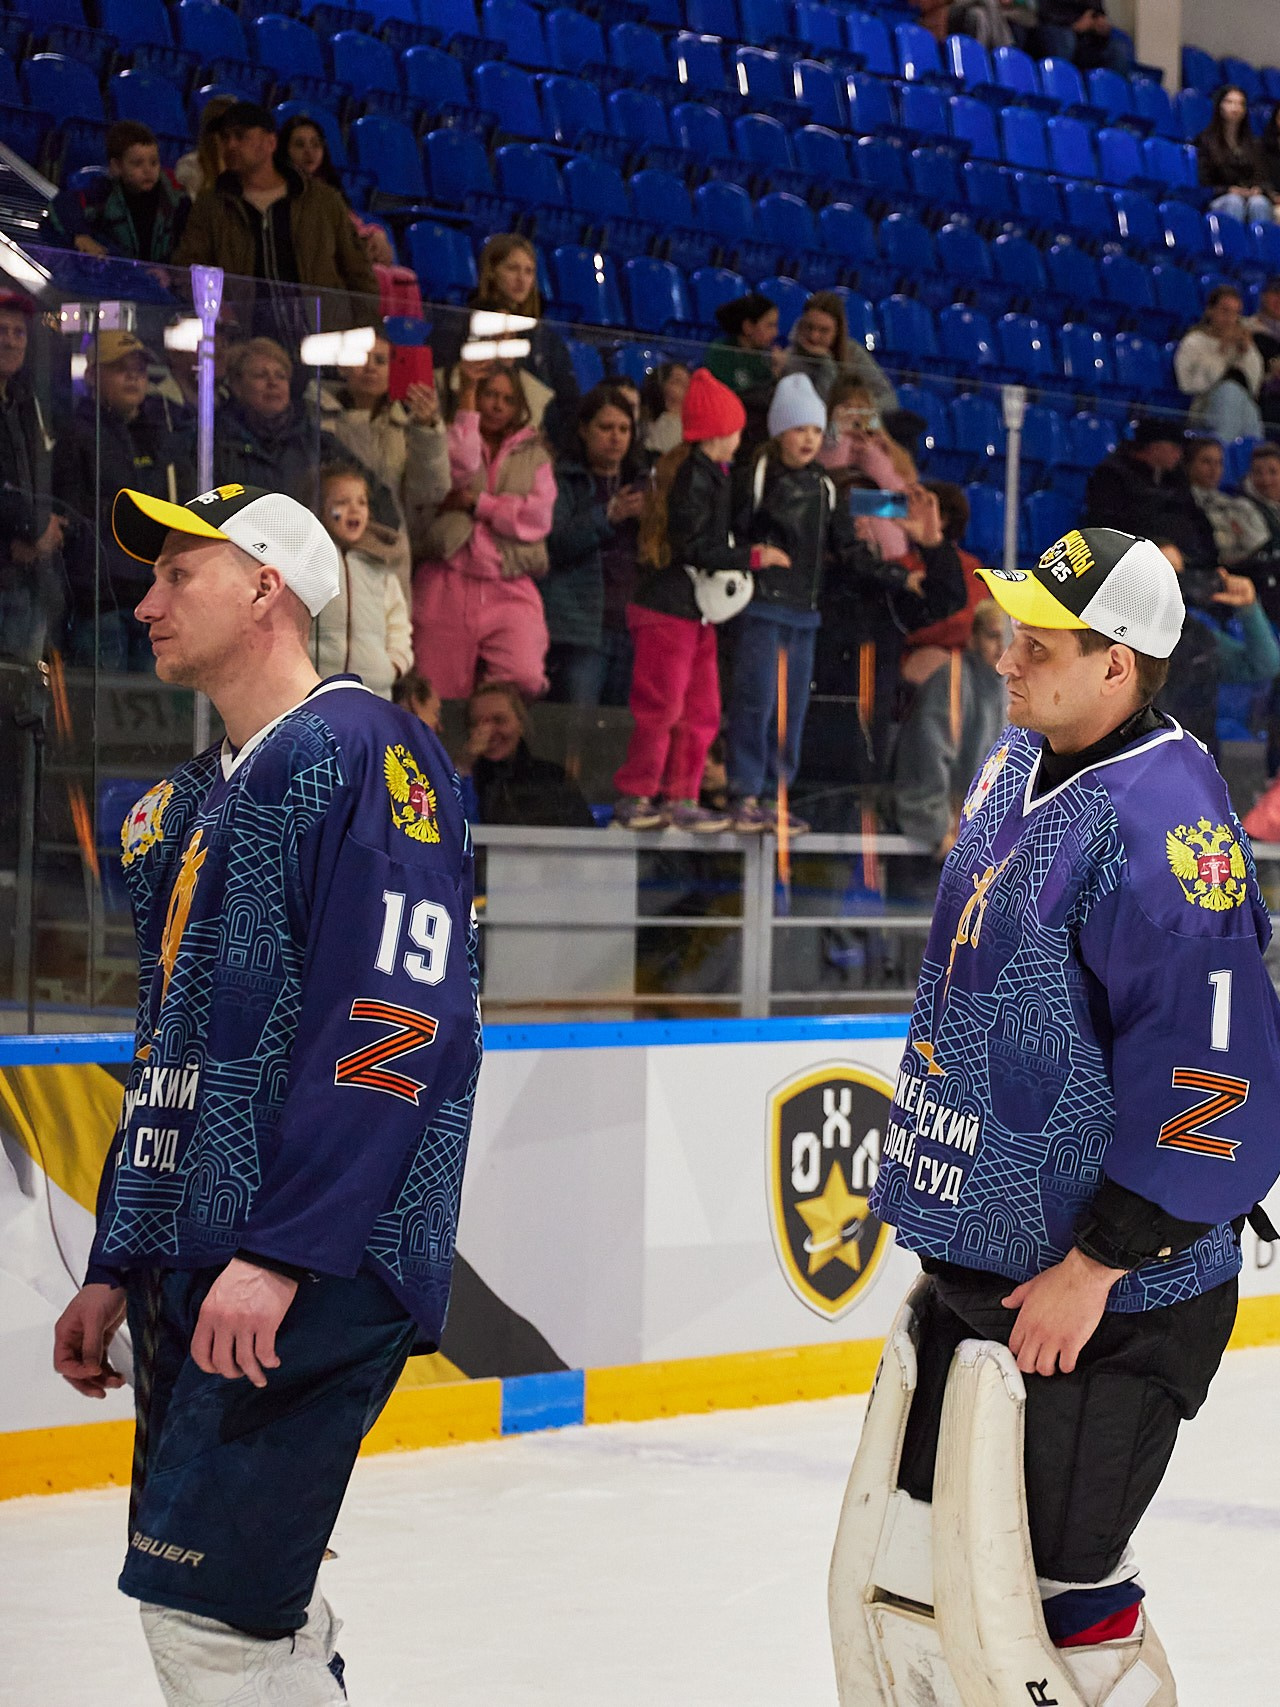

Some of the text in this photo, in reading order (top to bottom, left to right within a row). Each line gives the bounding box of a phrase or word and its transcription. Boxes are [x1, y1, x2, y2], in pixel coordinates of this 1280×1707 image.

[1050, 560, 1073, 583] 25
[374, 889, 452, 986] 19
[334, 998, 439, 1106] Z
[1208, 969, 1232, 1052] 1
[133, 1127, 179, 1172] СУД
[1156, 1067, 1250, 1161] Z
[914, 1155, 964, 1206] СУД
